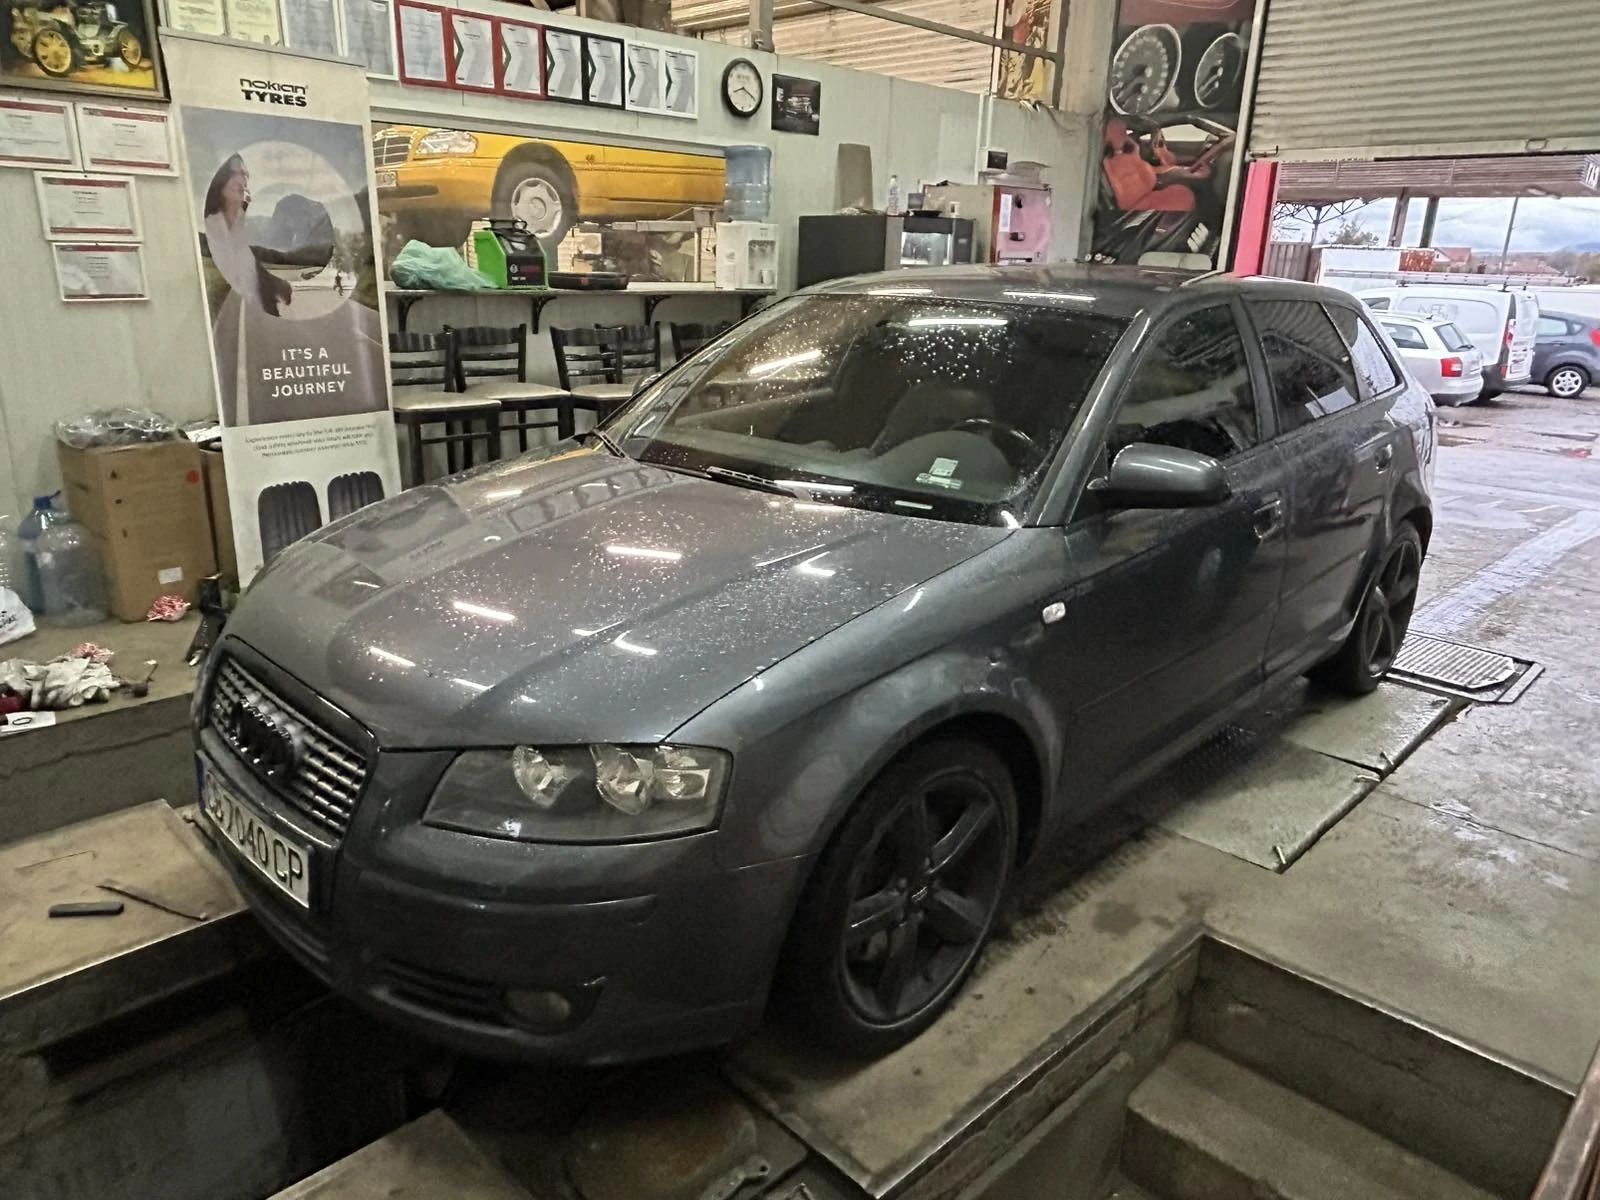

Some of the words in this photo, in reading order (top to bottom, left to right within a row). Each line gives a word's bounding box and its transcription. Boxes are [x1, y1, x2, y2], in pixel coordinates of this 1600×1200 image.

[239, 78, 306, 95] nokian
[241, 89, 307, 107] TYRES
[281, 348, 313, 361] IT'S
[318, 347, 329, 359] A
[262, 363, 352, 381] BEAUTIFUL
[271, 380, 346, 398] JOURNEY
